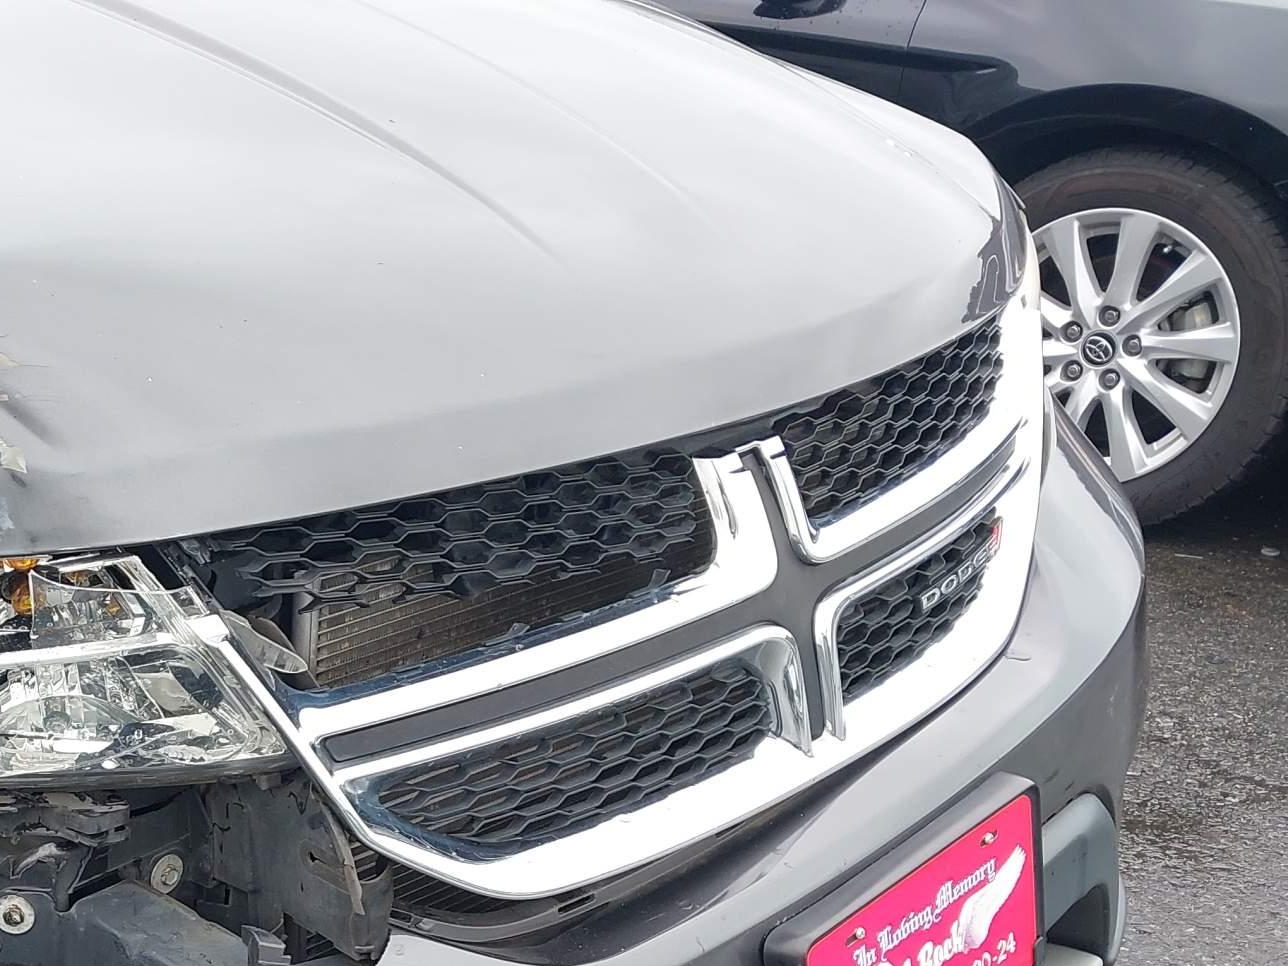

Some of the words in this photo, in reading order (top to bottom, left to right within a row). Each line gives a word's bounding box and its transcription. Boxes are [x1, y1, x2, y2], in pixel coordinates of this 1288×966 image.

[921, 546, 987, 609] DODGE
[877, 906, 933, 962] Loving
[933, 858, 997, 922] Memory
